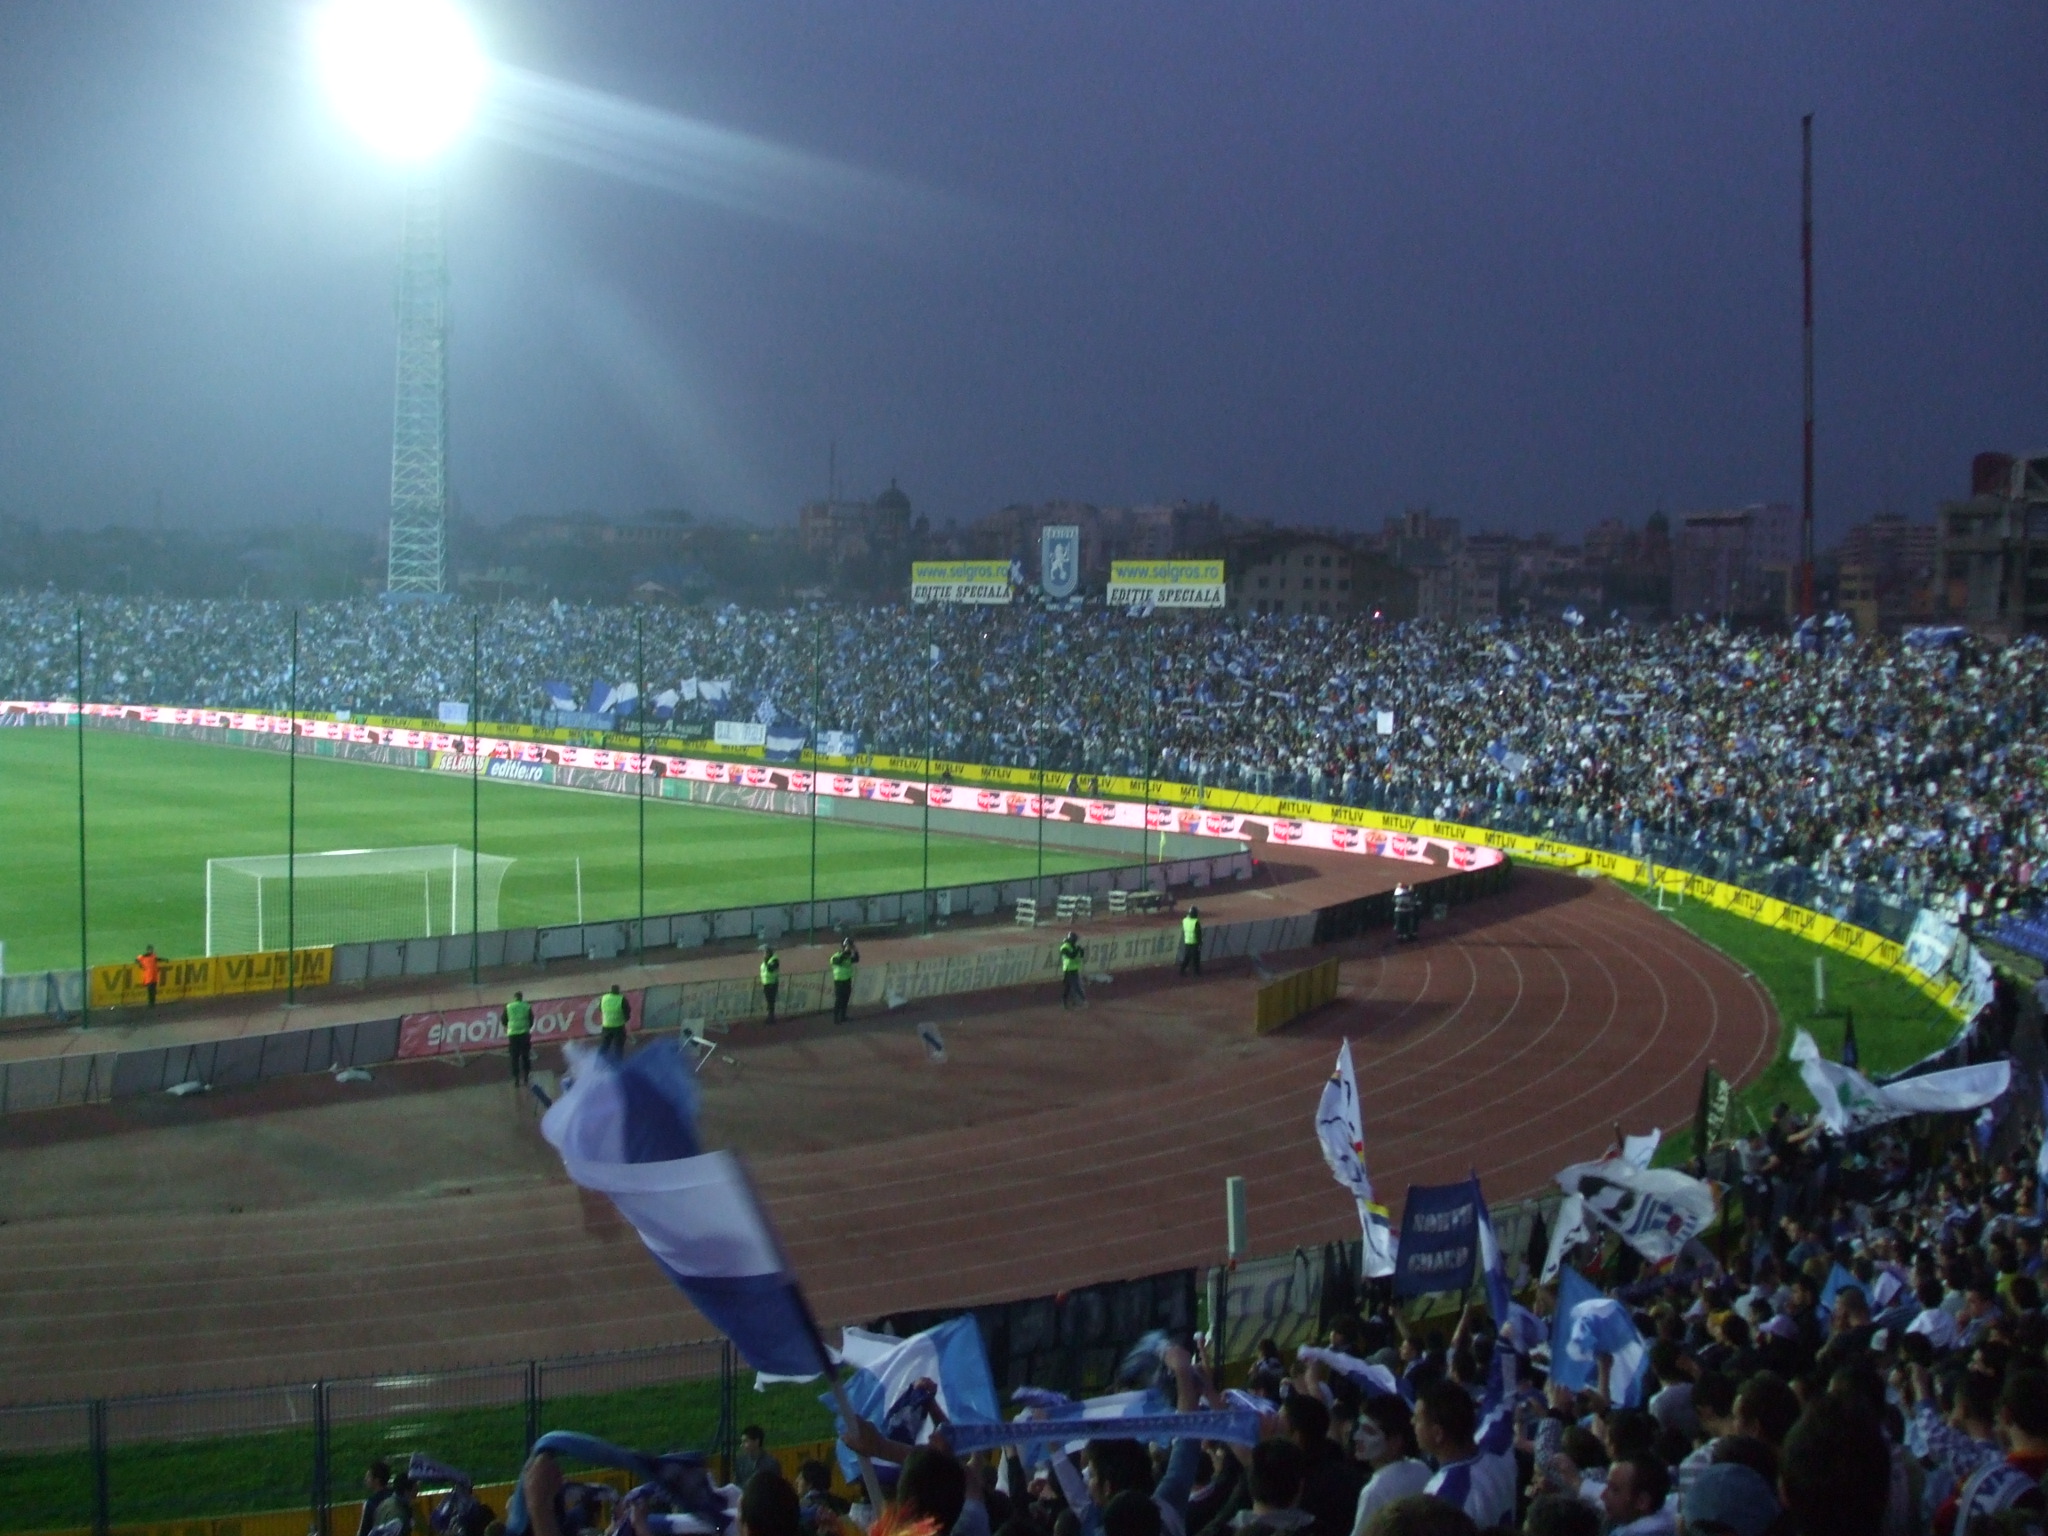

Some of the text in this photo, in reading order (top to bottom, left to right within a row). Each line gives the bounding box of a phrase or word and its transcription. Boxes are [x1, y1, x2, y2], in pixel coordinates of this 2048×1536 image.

[1116, 561, 1219, 583] www.selgros.ro
[490, 759, 543, 781] editie.ro
[888, 758, 918, 770] MITLIV
[980, 767, 1012, 780] MITLIV
[1279, 801, 1312, 815] MITLIV
[1331, 807, 1364, 822] MITLIV
[1382, 815, 1415, 830] MITLIV
[1433, 823, 1466, 840] MITLIV
[1484, 831, 1517, 848] MITLIV
[1584, 852, 1617, 871] MTLIV
[1783, 905, 1815, 930] MITLIV
